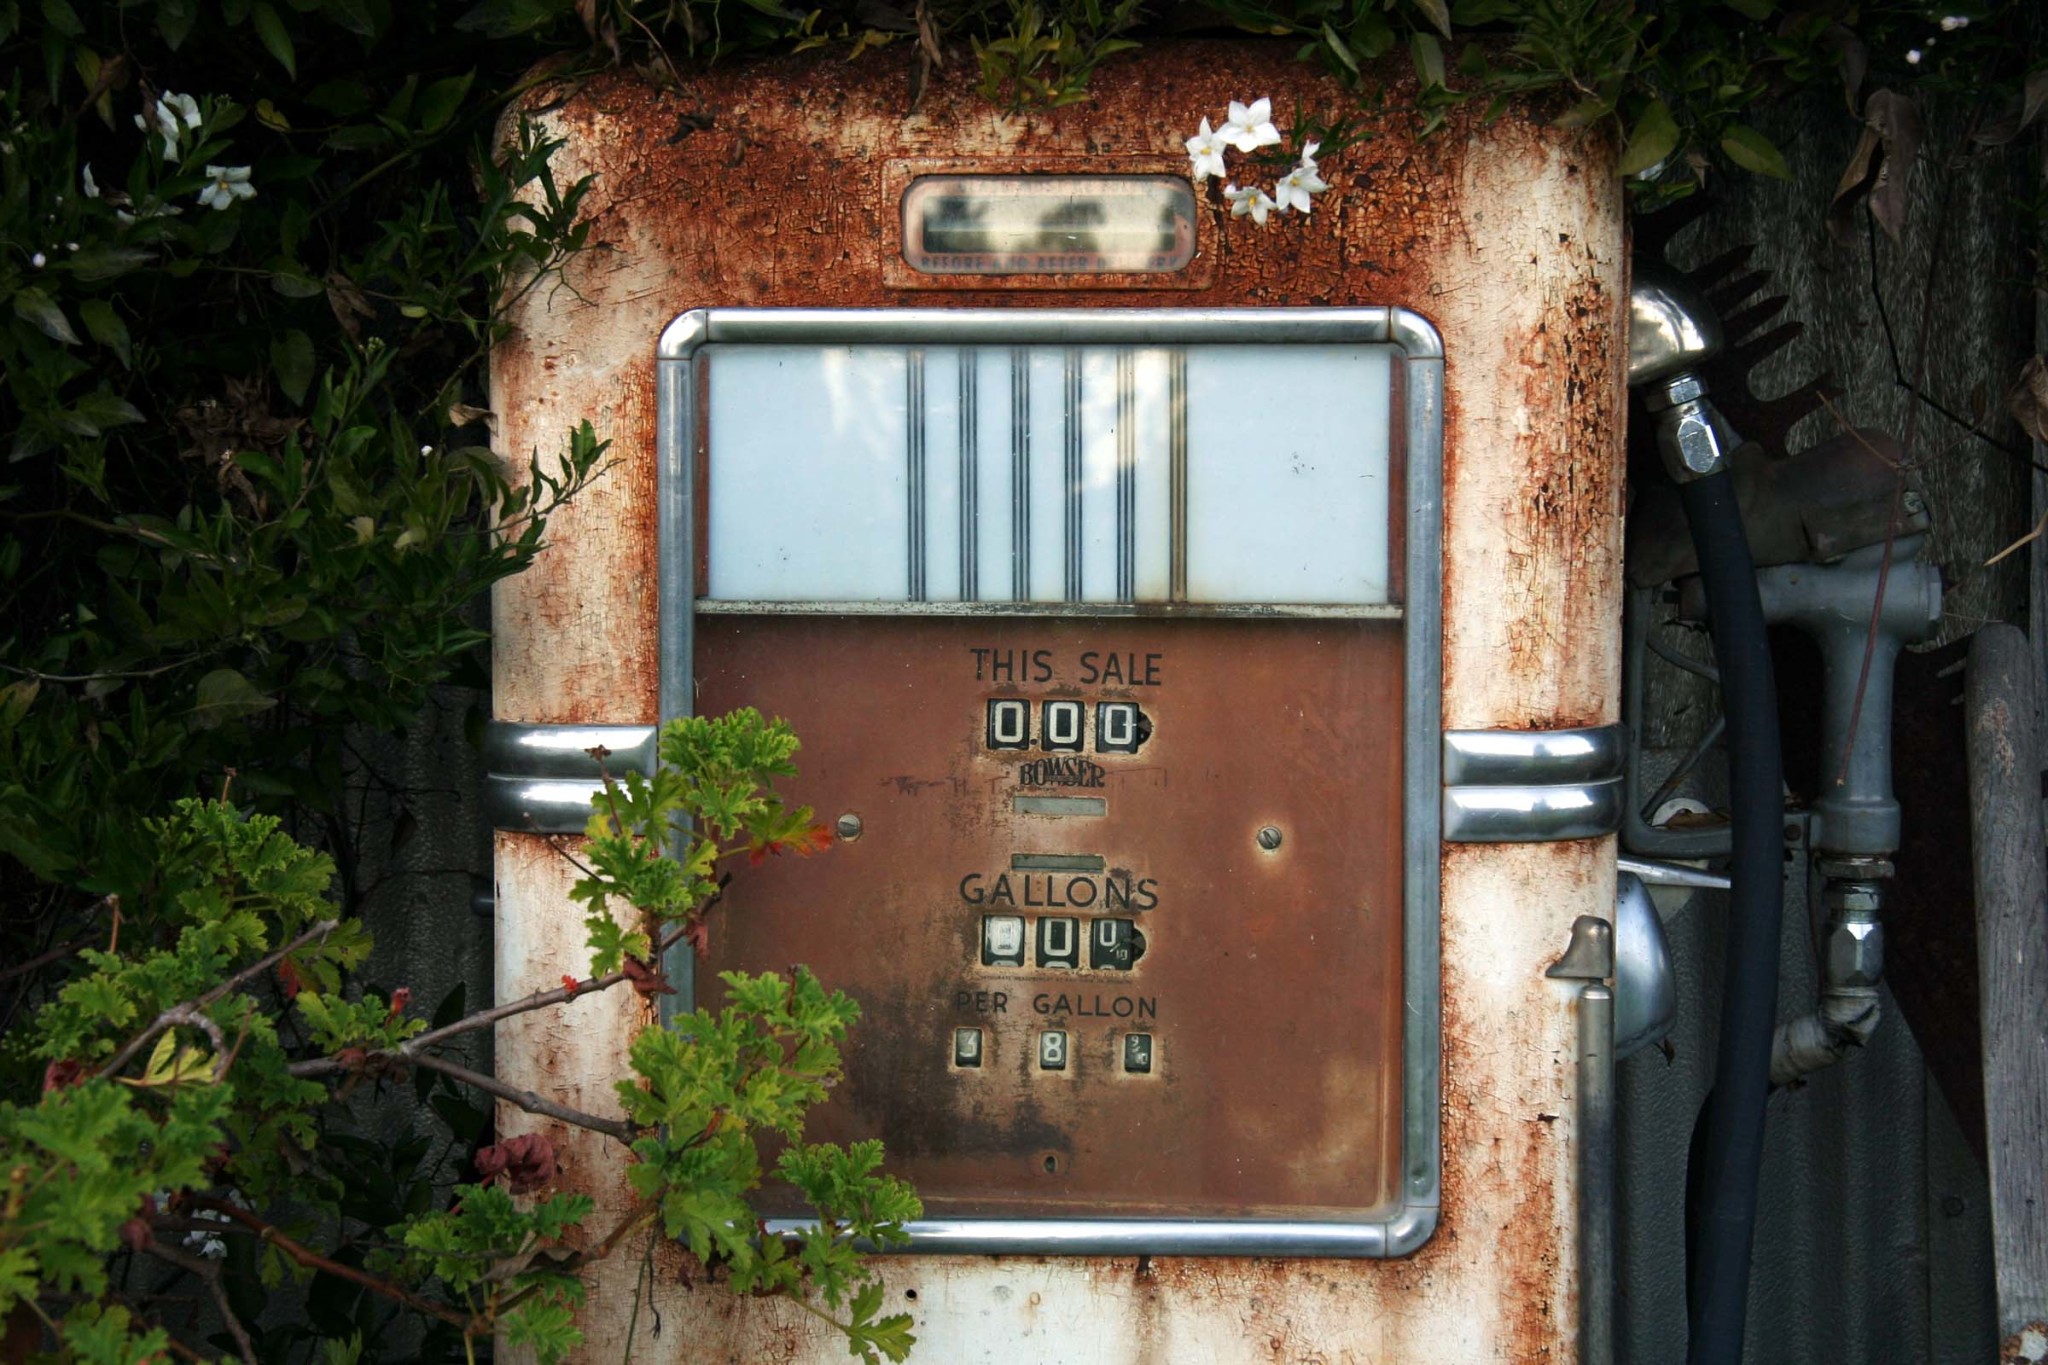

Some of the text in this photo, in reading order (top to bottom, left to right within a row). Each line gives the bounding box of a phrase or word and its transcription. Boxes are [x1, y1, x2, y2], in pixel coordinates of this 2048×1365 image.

[970, 649, 1162, 686] THIS SALE
[1019, 757, 1106, 788] BOWSER
[959, 873, 1158, 911] GALLONS
[957, 991, 1157, 1019] PER GALLON
[1043, 1033, 1063, 1062] 8
